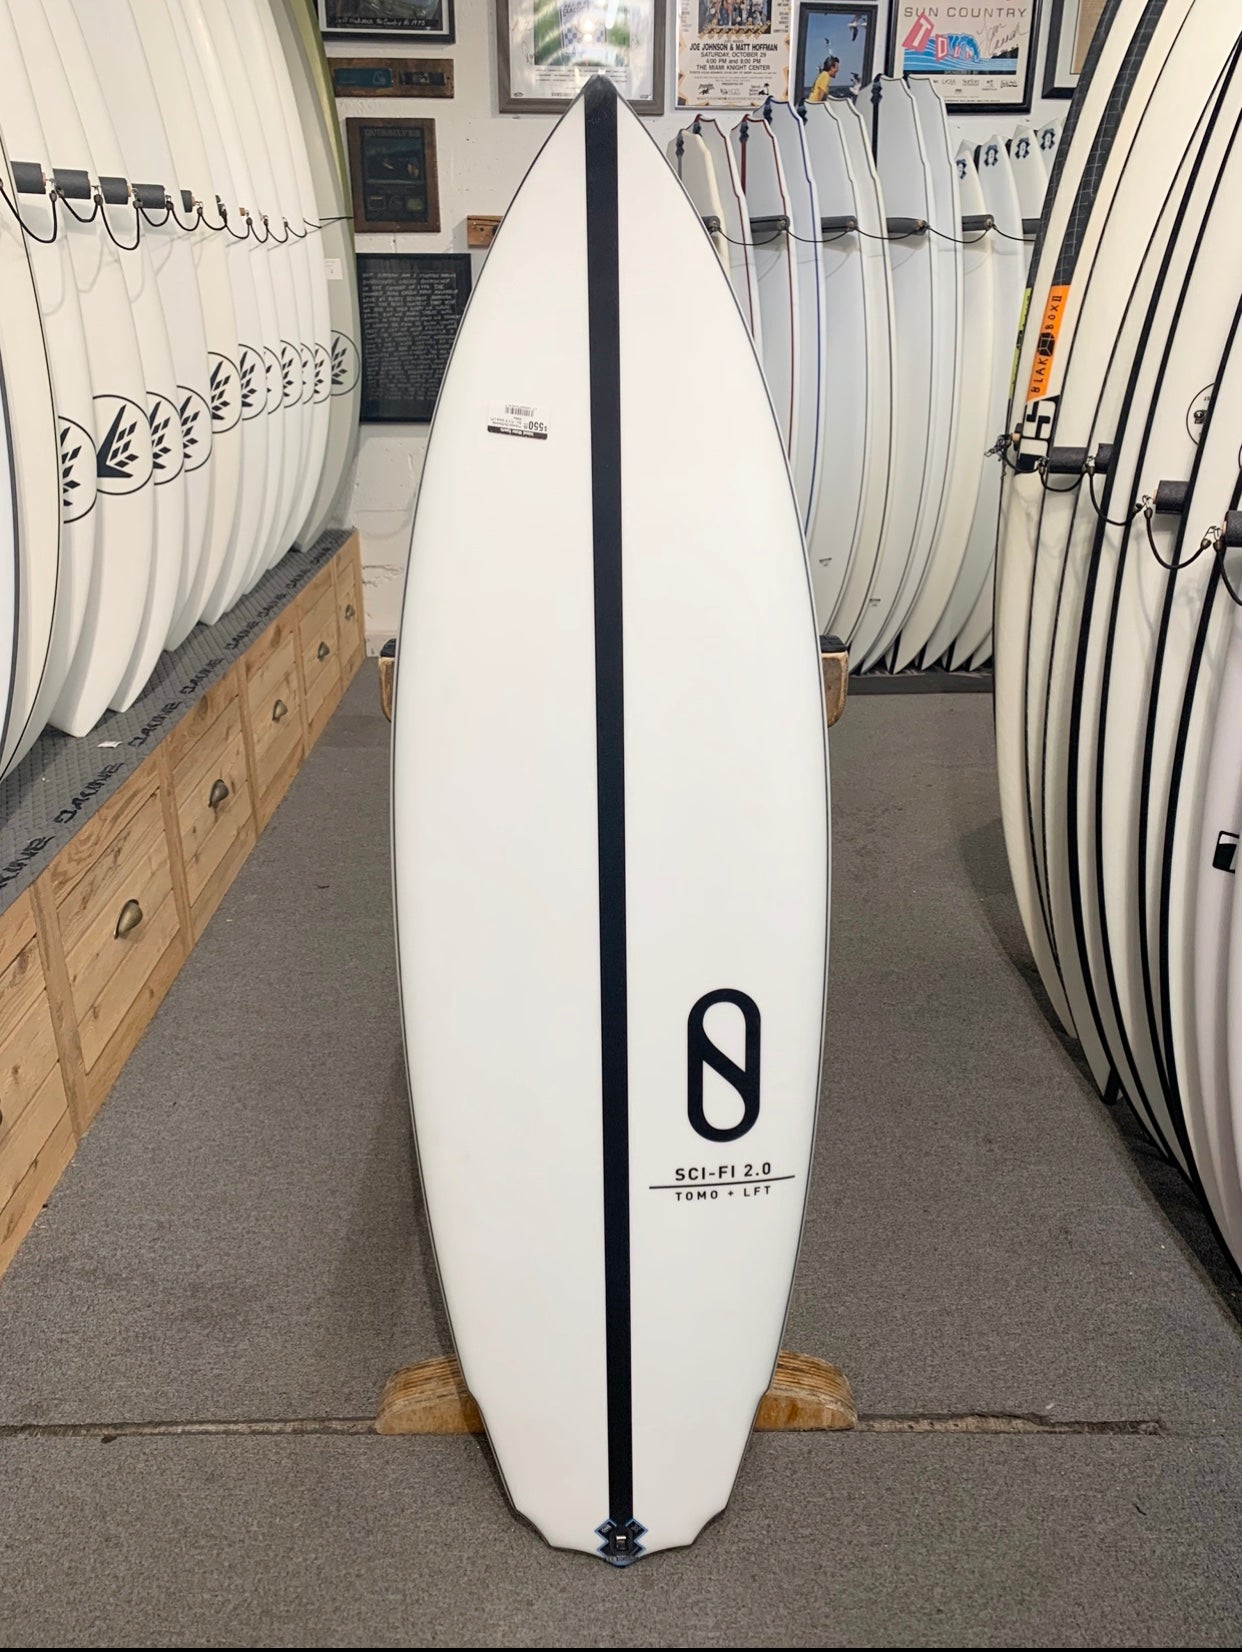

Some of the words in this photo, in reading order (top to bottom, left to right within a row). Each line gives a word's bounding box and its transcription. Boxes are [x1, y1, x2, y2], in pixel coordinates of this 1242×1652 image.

[904, 7, 939, 18] SUN
[947, 7, 1027, 18] COUNTRY
[690, 43, 700, 51] JOE
[702, 43, 728, 51] JOHNSON
[736, 43, 750, 51] MATT
[1030, 358, 1048, 392] BLAK
[0, 836, 55, 888] KINE
[54, 763, 124, 824] DAKINE
[128, 701, 183, 747] DAKINE
[675, 1165, 735, 1181] SCI-FI
[744, 1162, 771, 1177] 2.0
[675, 1190, 718, 1202] TOMO
[744, 1185, 771, 1197] LFT
